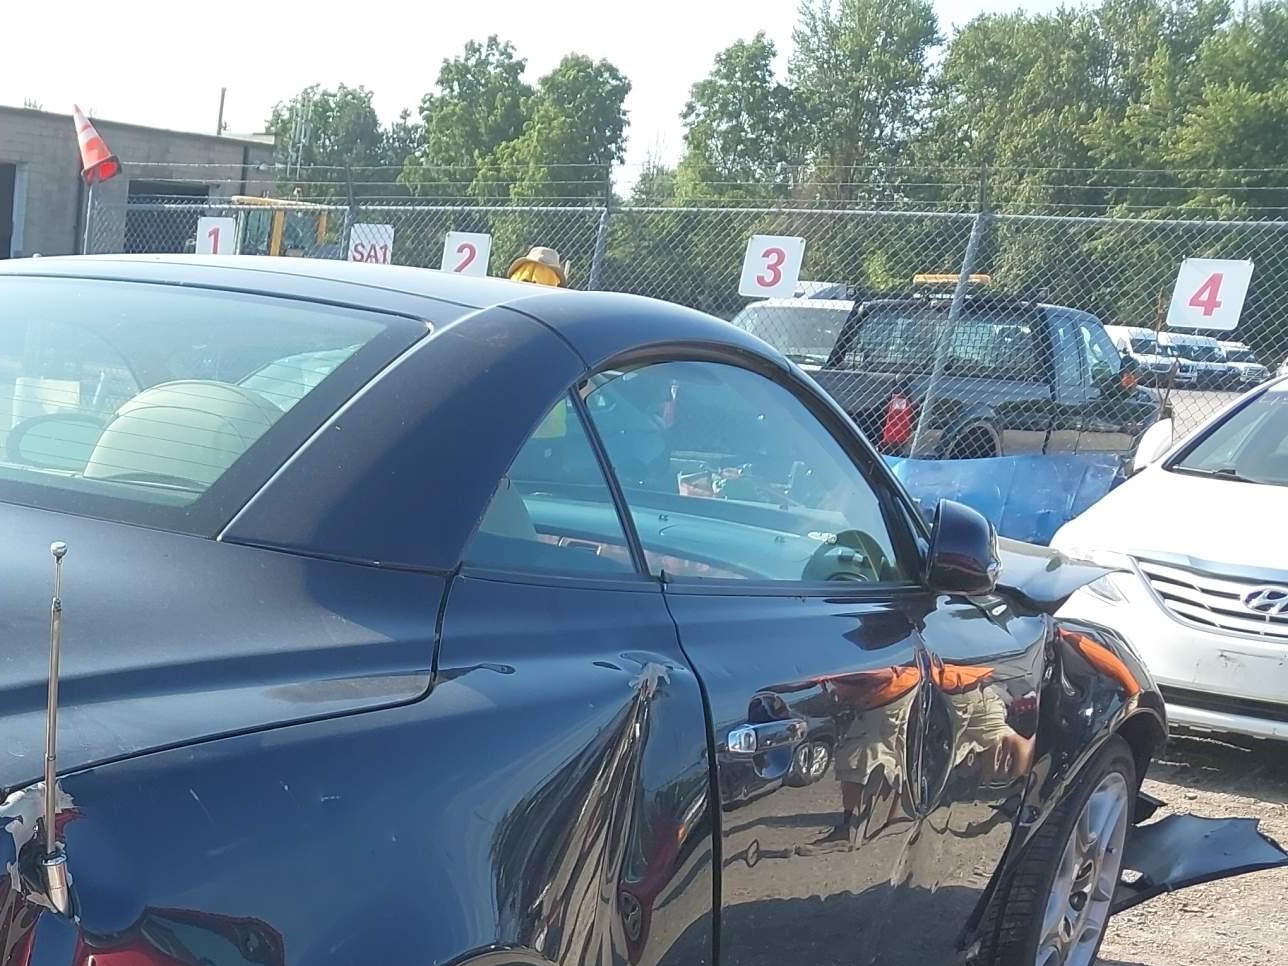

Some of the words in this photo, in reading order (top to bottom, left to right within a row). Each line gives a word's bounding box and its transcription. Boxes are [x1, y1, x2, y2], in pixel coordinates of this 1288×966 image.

[207, 227, 220, 255] 1
[352, 242, 389, 265] SA1
[454, 242, 477, 273] 2
[756, 247, 786, 288] 3
[1188, 272, 1225, 317] 4
